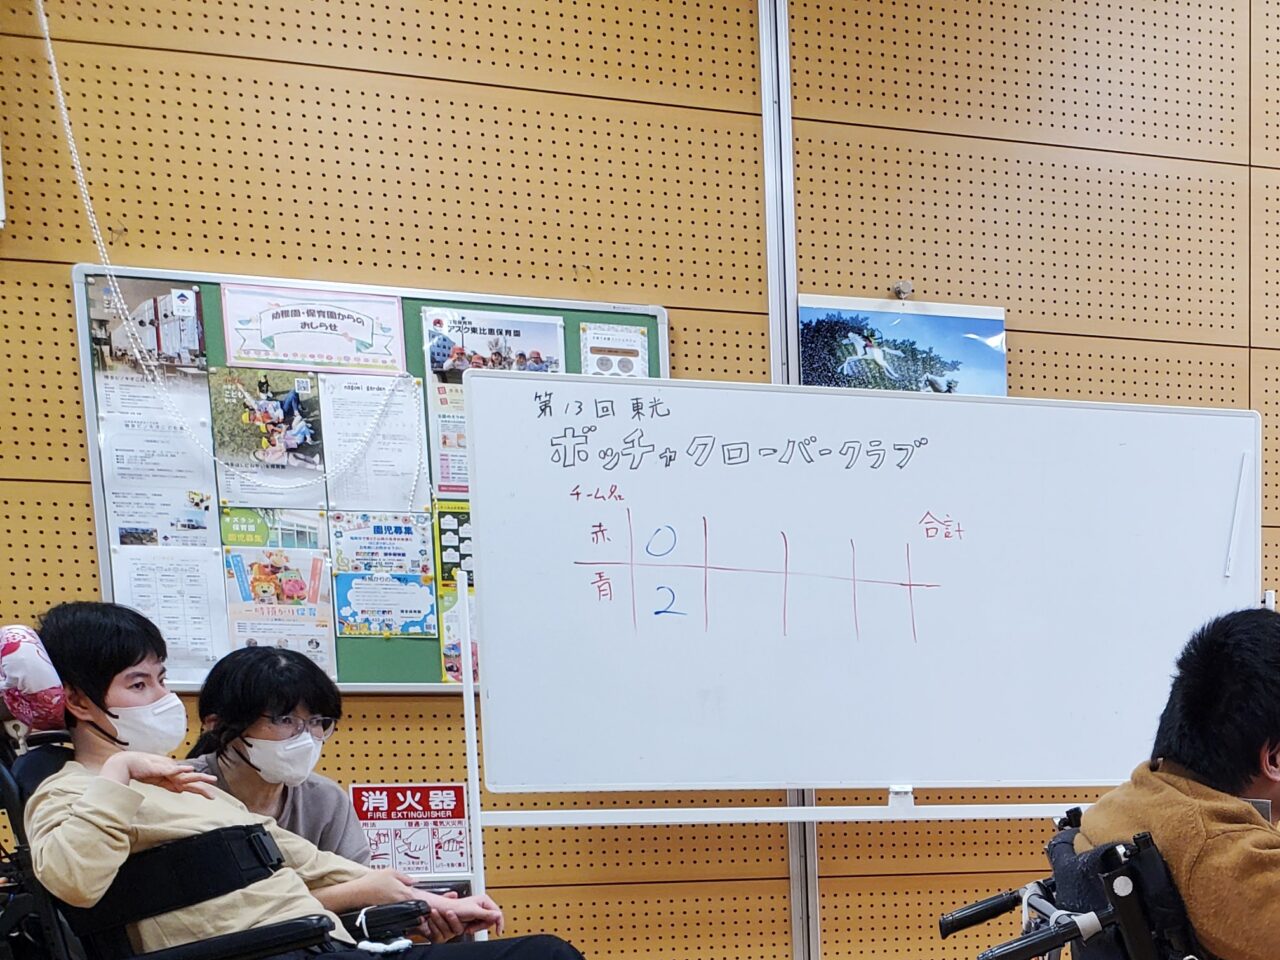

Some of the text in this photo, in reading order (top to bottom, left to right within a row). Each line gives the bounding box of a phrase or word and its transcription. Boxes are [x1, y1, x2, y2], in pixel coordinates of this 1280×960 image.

[271, 308, 366, 327] 幼稚園・保育園からの
[300, 322, 339, 332] おしらせ
[447, 325, 521, 337] アスク東比恵保育園
[549, 425, 929, 470] ボッチャクローバークラブ
[569, 484, 625, 501] チーム名
[232, 524, 256, 532] 保育園
[373, 525, 413, 535] 園児募集
[590, 523, 612, 545] 赤
[918, 510, 966, 540] 合計
[590, 571, 688, 616] 青 2
[361, 790, 457, 812] 消火器
[367, 810, 453, 820] FIRE EXTINGUISHER
